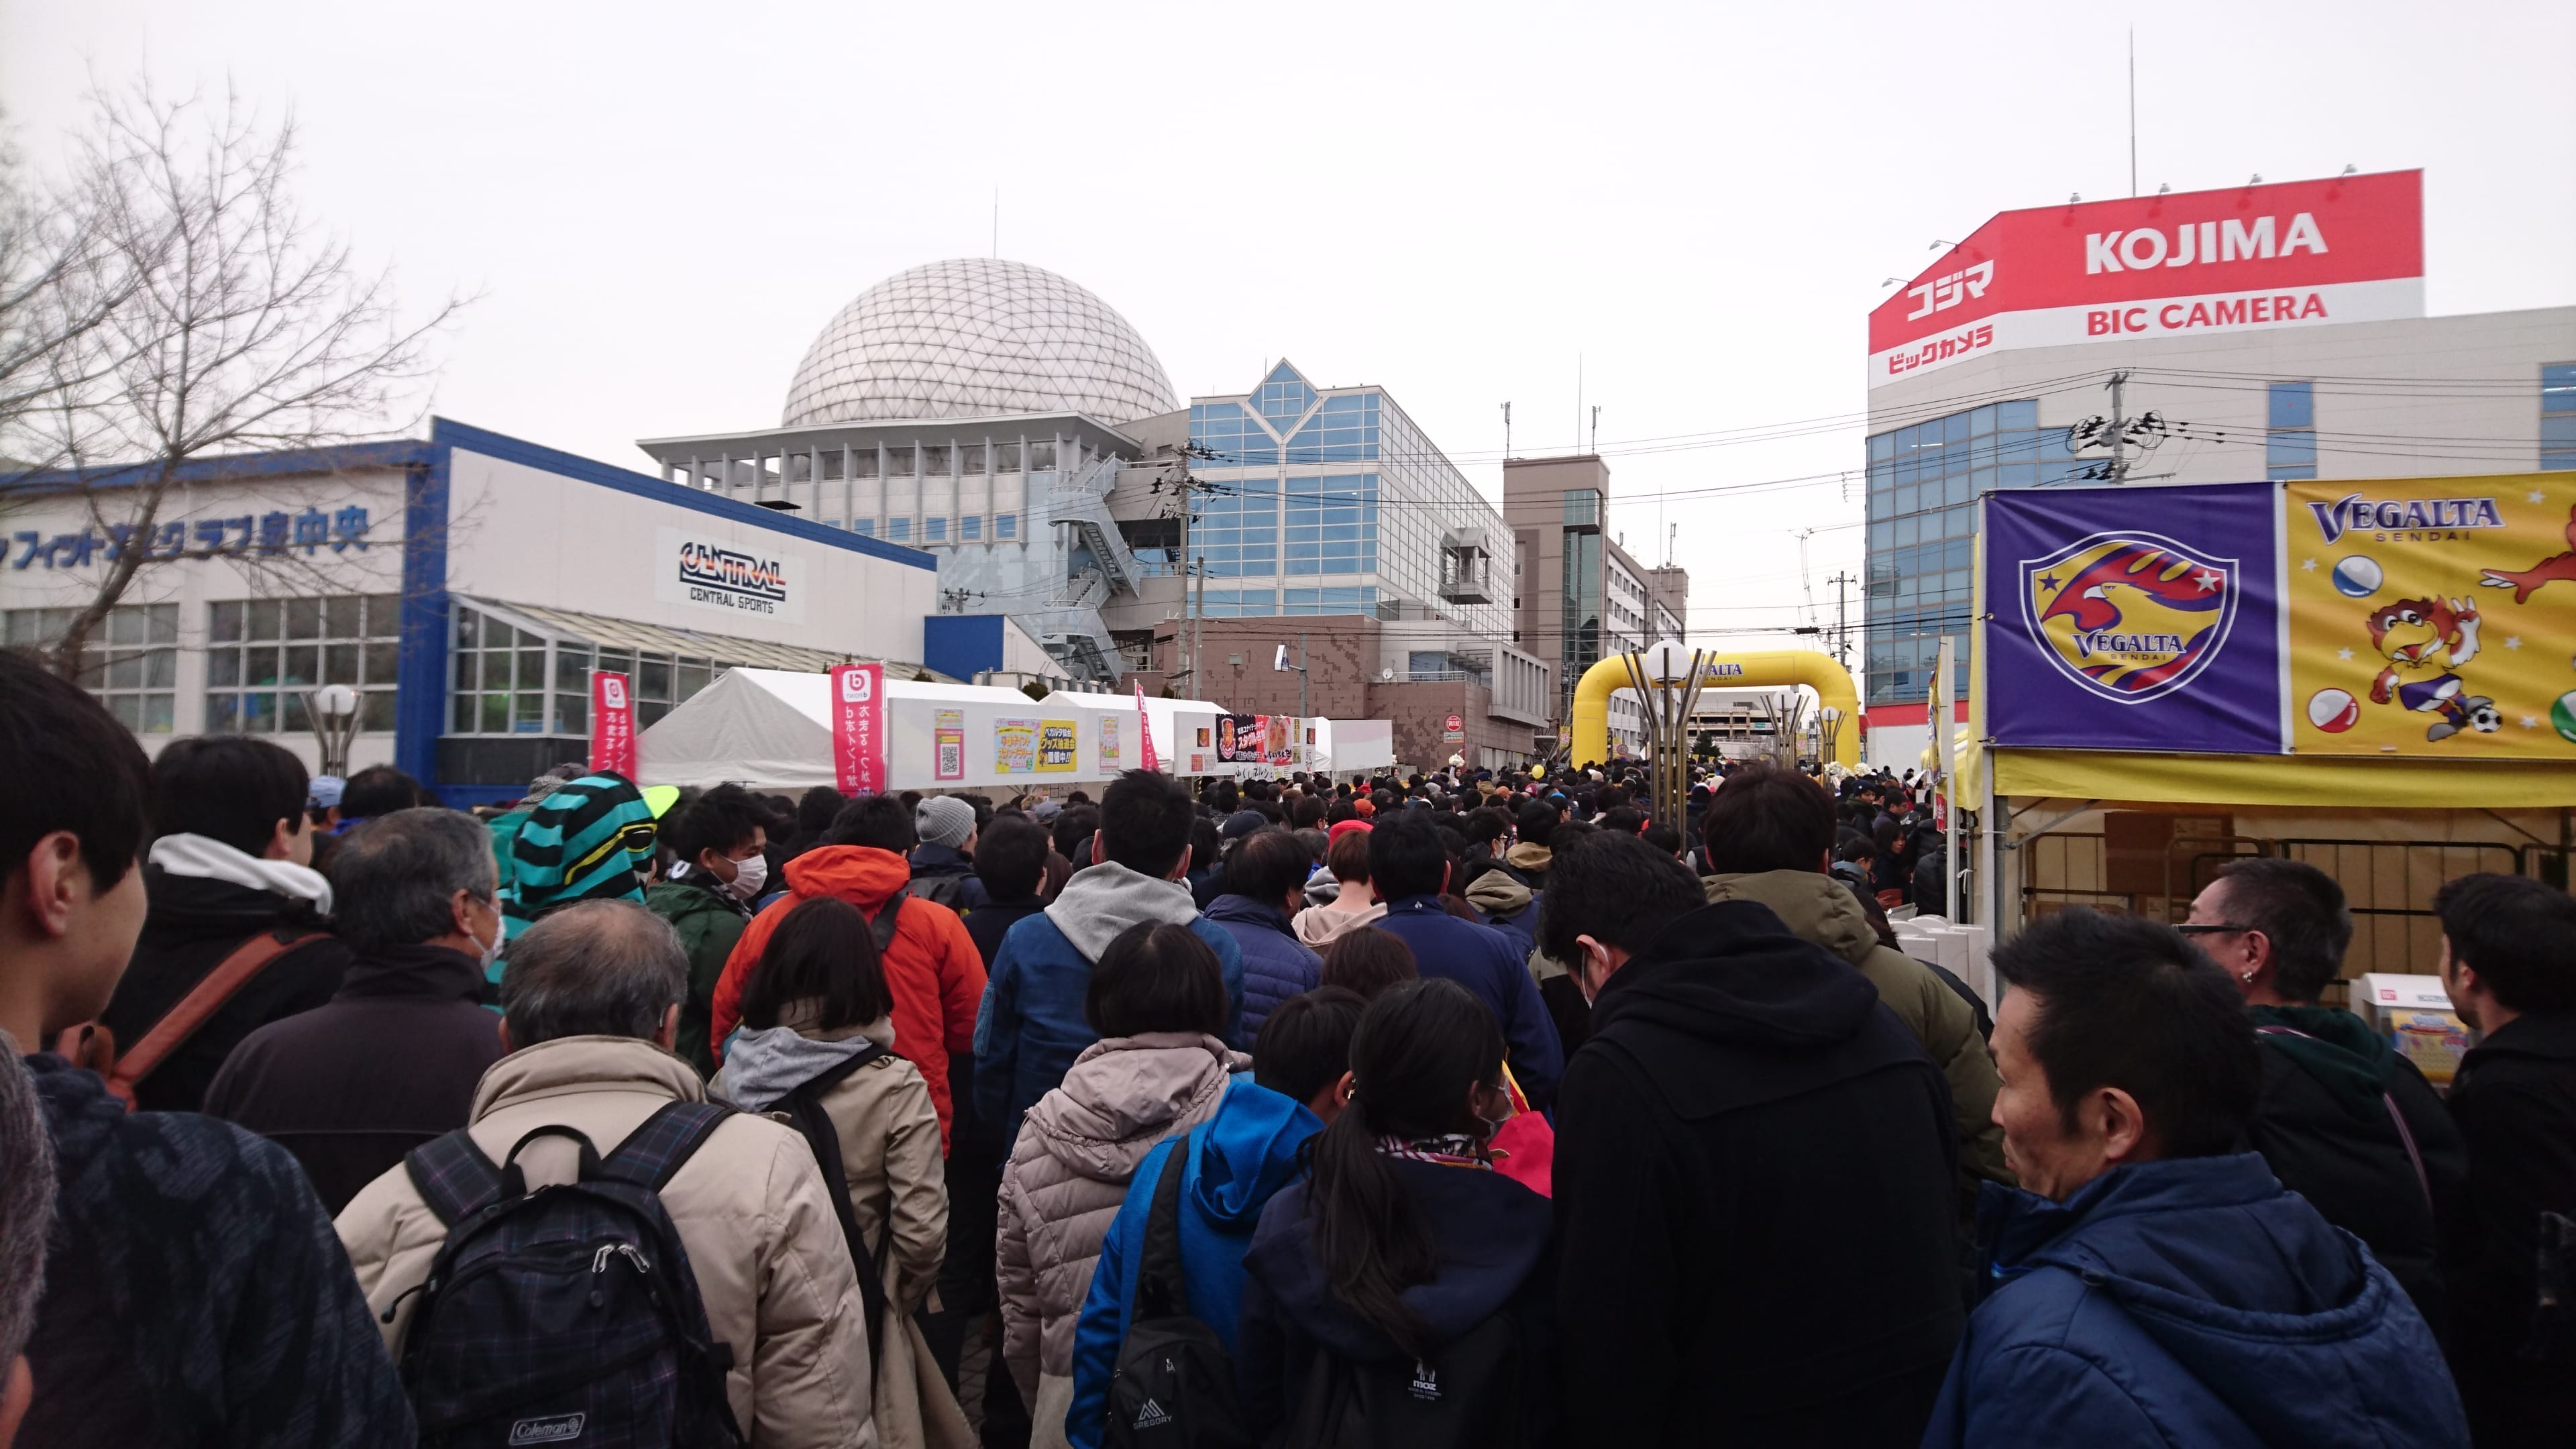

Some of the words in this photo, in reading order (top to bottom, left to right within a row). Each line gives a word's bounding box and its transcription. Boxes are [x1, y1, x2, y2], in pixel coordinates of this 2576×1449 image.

[2086, 212, 2328, 275] KOJIMA
[1907, 259, 1994, 322] コジマ
[2088, 307, 2148, 335] BIC
[2159, 292, 2328, 329] CAMERA
[1888, 323, 1994, 375] ビックカメラ
[2307, 492, 2507, 545] VEGALTA
[2375, 531, 2471, 542] SENDAI
[679, 541, 786, 602] CENTRAL
[690, 587, 734, 607] CENTRAL
[738, 596, 773, 614] SPORTS
[2071, 629, 2187, 659] VEGALTA
[2110, 653, 2166, 661] SENDAI
[517, 1422, 567, 1437] Coleman
[1133, 1415, 1172, 1430] GREGORY
